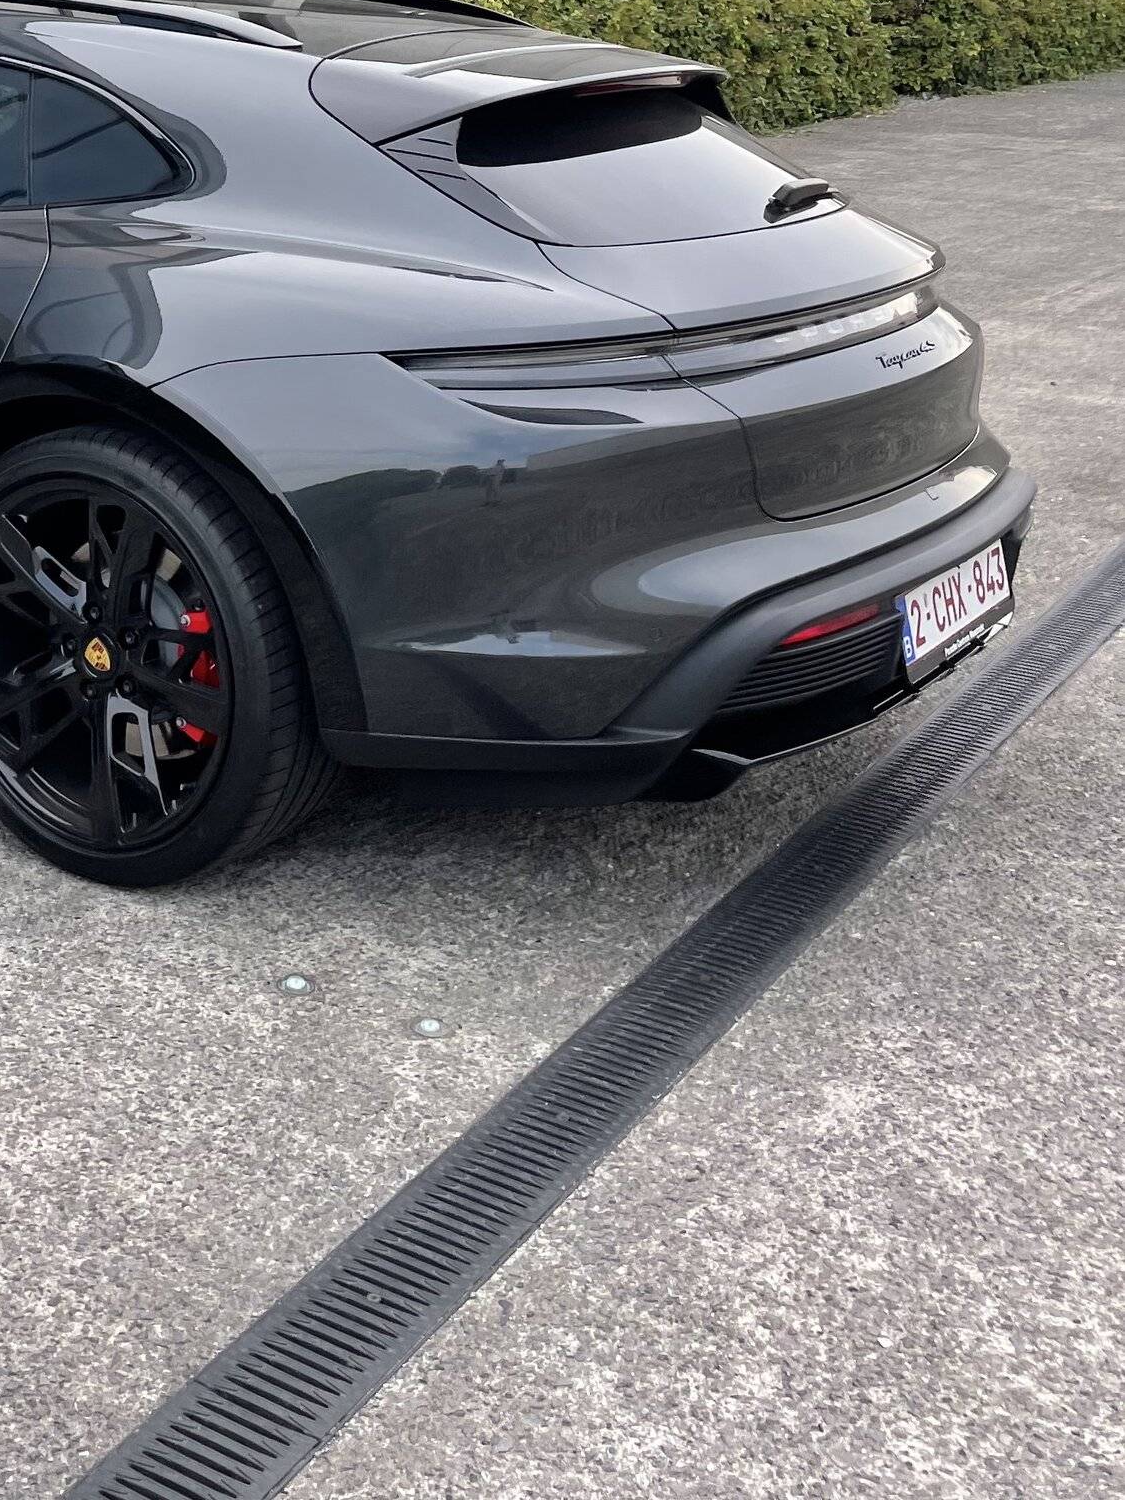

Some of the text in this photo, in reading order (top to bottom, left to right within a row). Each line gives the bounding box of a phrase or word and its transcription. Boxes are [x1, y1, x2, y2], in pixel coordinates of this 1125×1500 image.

[875, 348, 921, 369] Taycan
[910, 546, 1005, 649] 2-CHX-843
[903, 636, 912, 659] B
